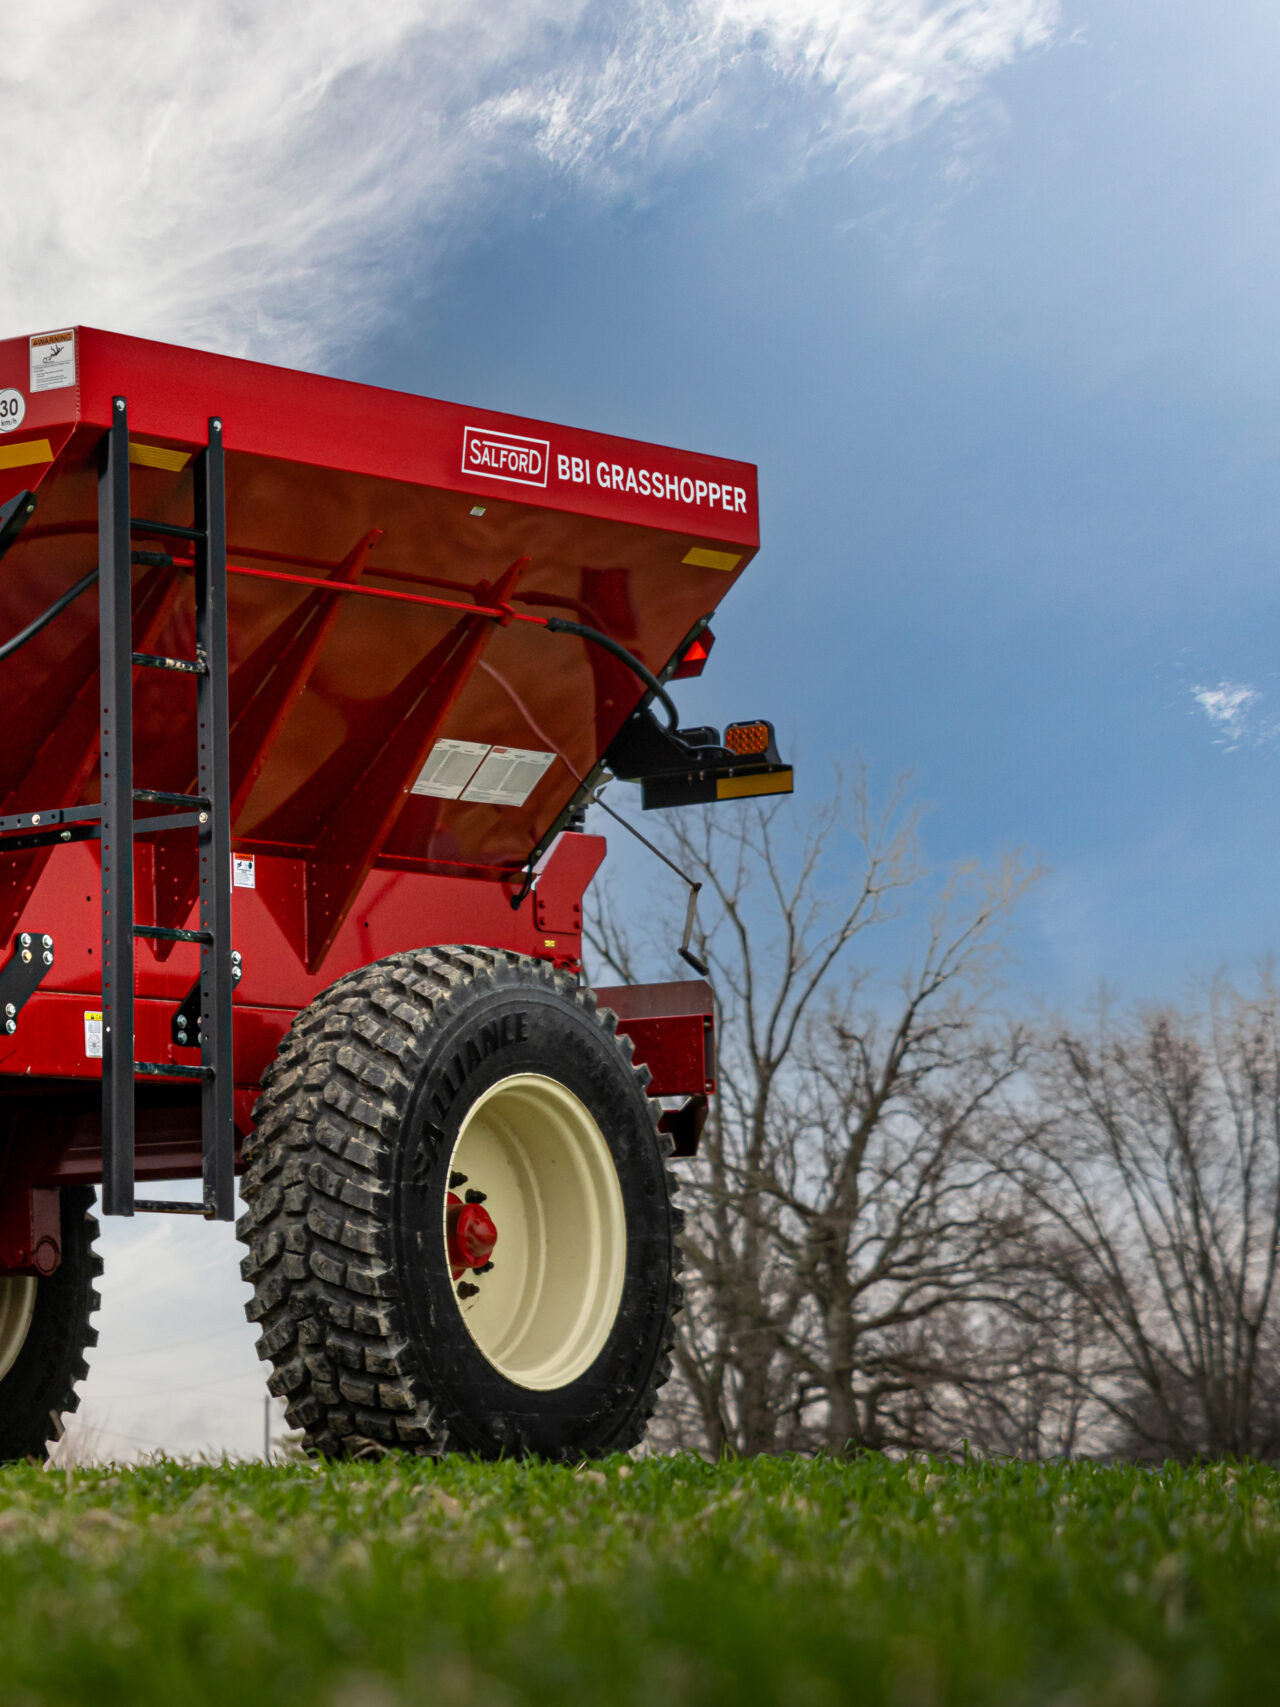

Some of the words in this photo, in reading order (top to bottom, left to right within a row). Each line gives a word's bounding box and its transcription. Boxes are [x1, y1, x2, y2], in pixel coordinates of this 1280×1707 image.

[37, 332, 72, 346] WARNING
[0, 398, 19, 418] 30
[0, 418, 17, 427] km/h
[469, 438, 542, 475] SALFORD
[557, 454, 591, 485] BBI
[596, 461, 747, 514] GRASSHOPPER
